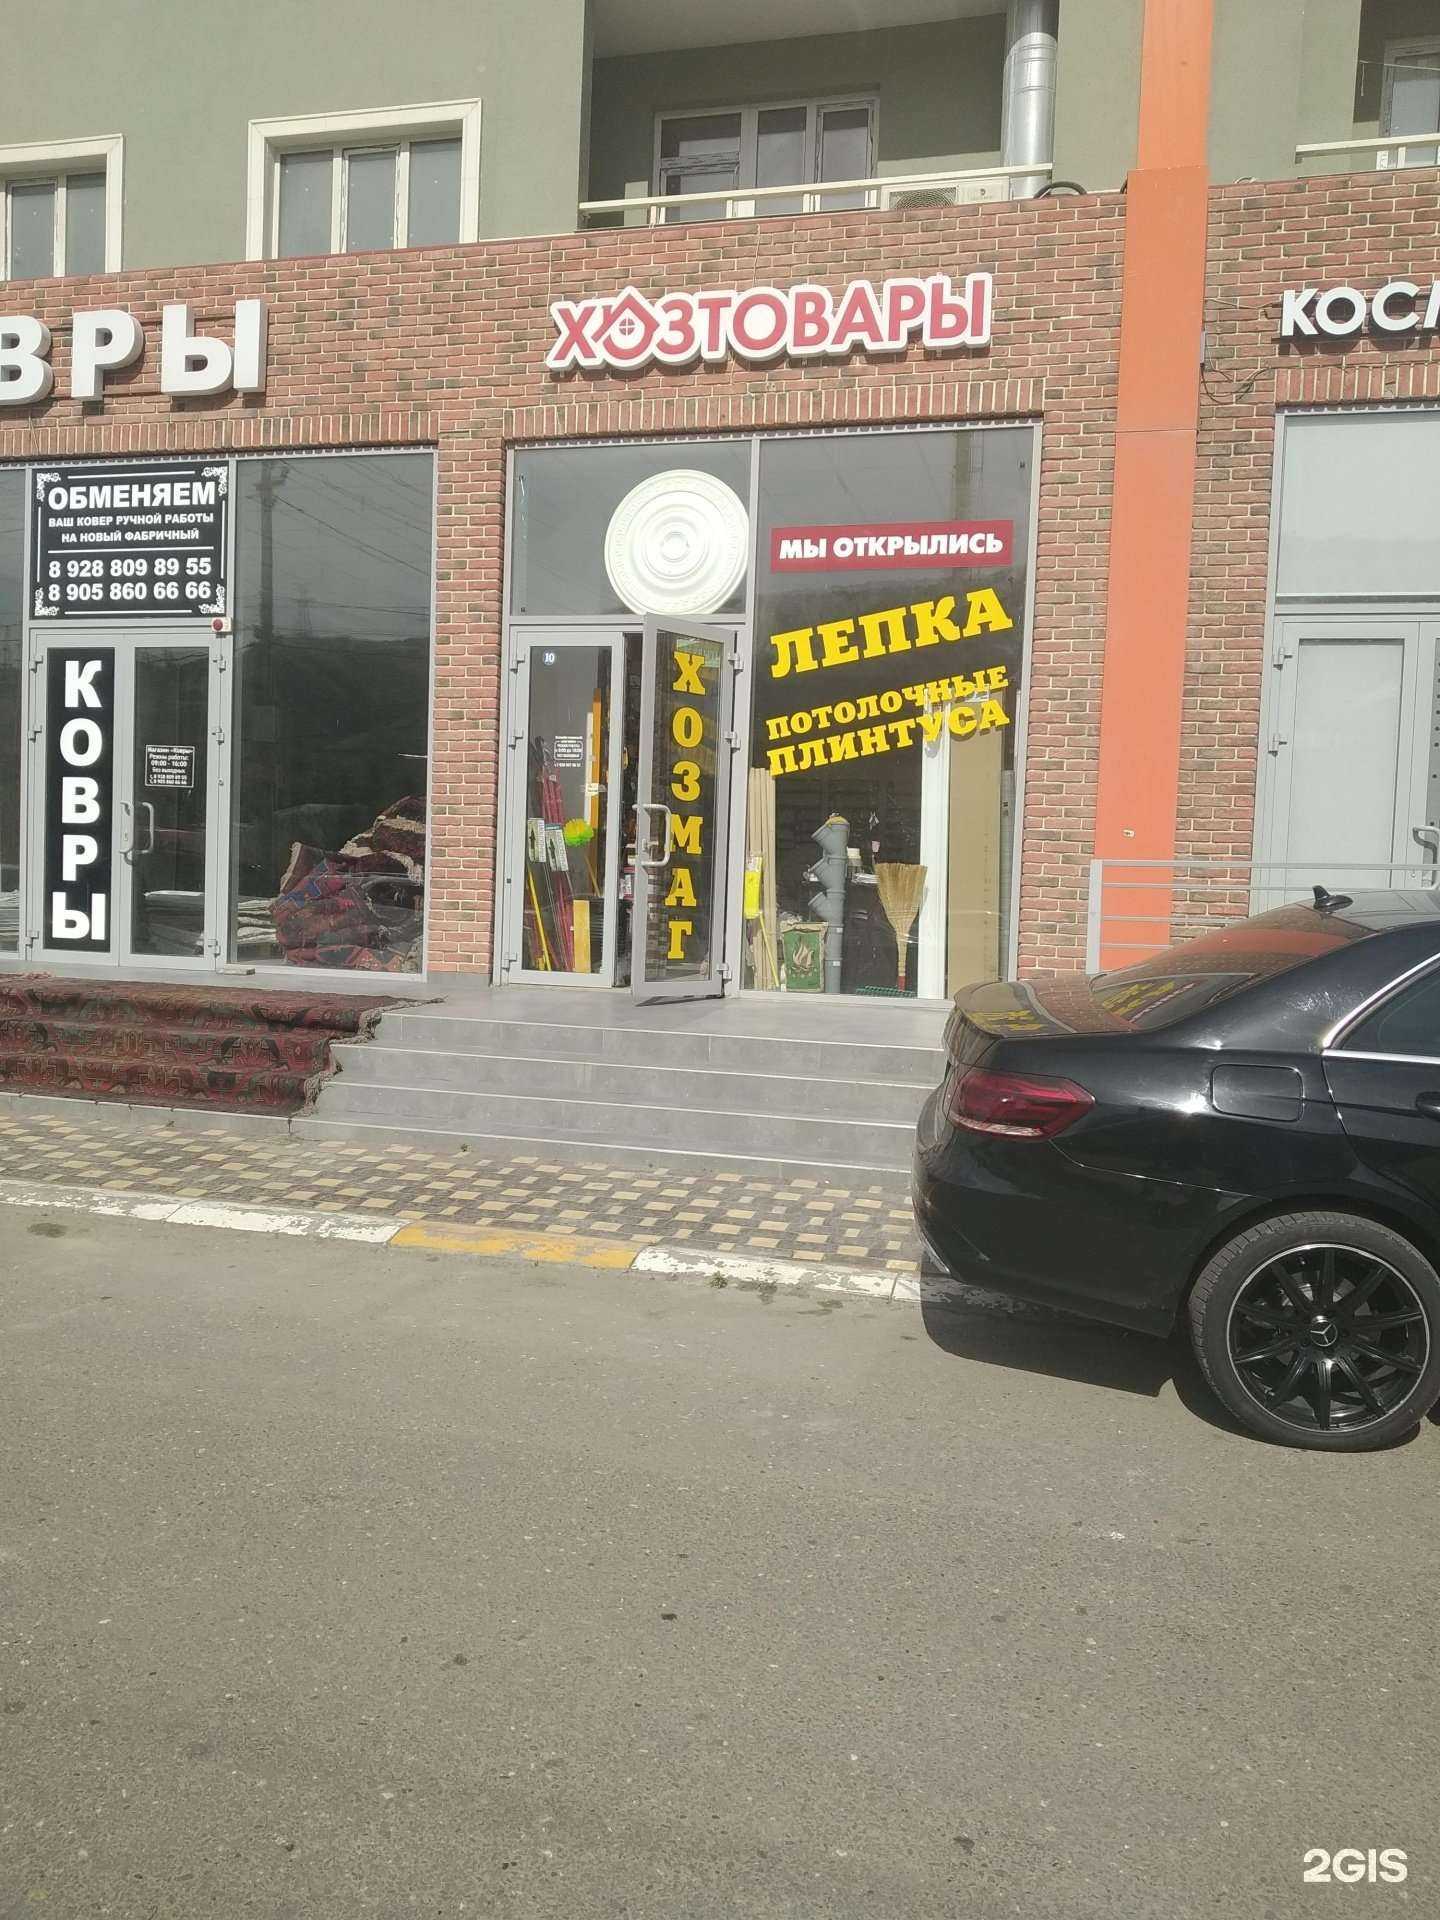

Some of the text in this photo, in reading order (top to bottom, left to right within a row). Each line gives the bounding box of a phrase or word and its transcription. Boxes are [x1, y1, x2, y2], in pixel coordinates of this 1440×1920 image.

[546, 273, 992, 371] ХОЗТОВАРЫ
[48, 481, 216, 510] ОБМЕНЯЕМ
[48, 512, 214, 527] ВАШ КОВЕР РУЧНОЙ РАБОТЫ
[61, 528, 199, 543] НА НОВЫЙ ФАБРИЧНЫЙ
[779, 532, 1003, 559] МЫ ОТКРЫЛИСЬ
[49, 557, 212, 577] 8 928 809 89 55
[48, 581, 211, 600] 8 905 860 66 66
[770, 588, 1014, 678] ЛЕПКА
[543, 652, 555, 662] 10
[766, 665, 1009, 741] ПОТОЛОЧНЫЕ
[766, 699, 1010, 776] ПЛИНТУСА
[52, 660, 106, 940] КОВРЫ
[664, 651, 706, 959] ХОЗМАГ
